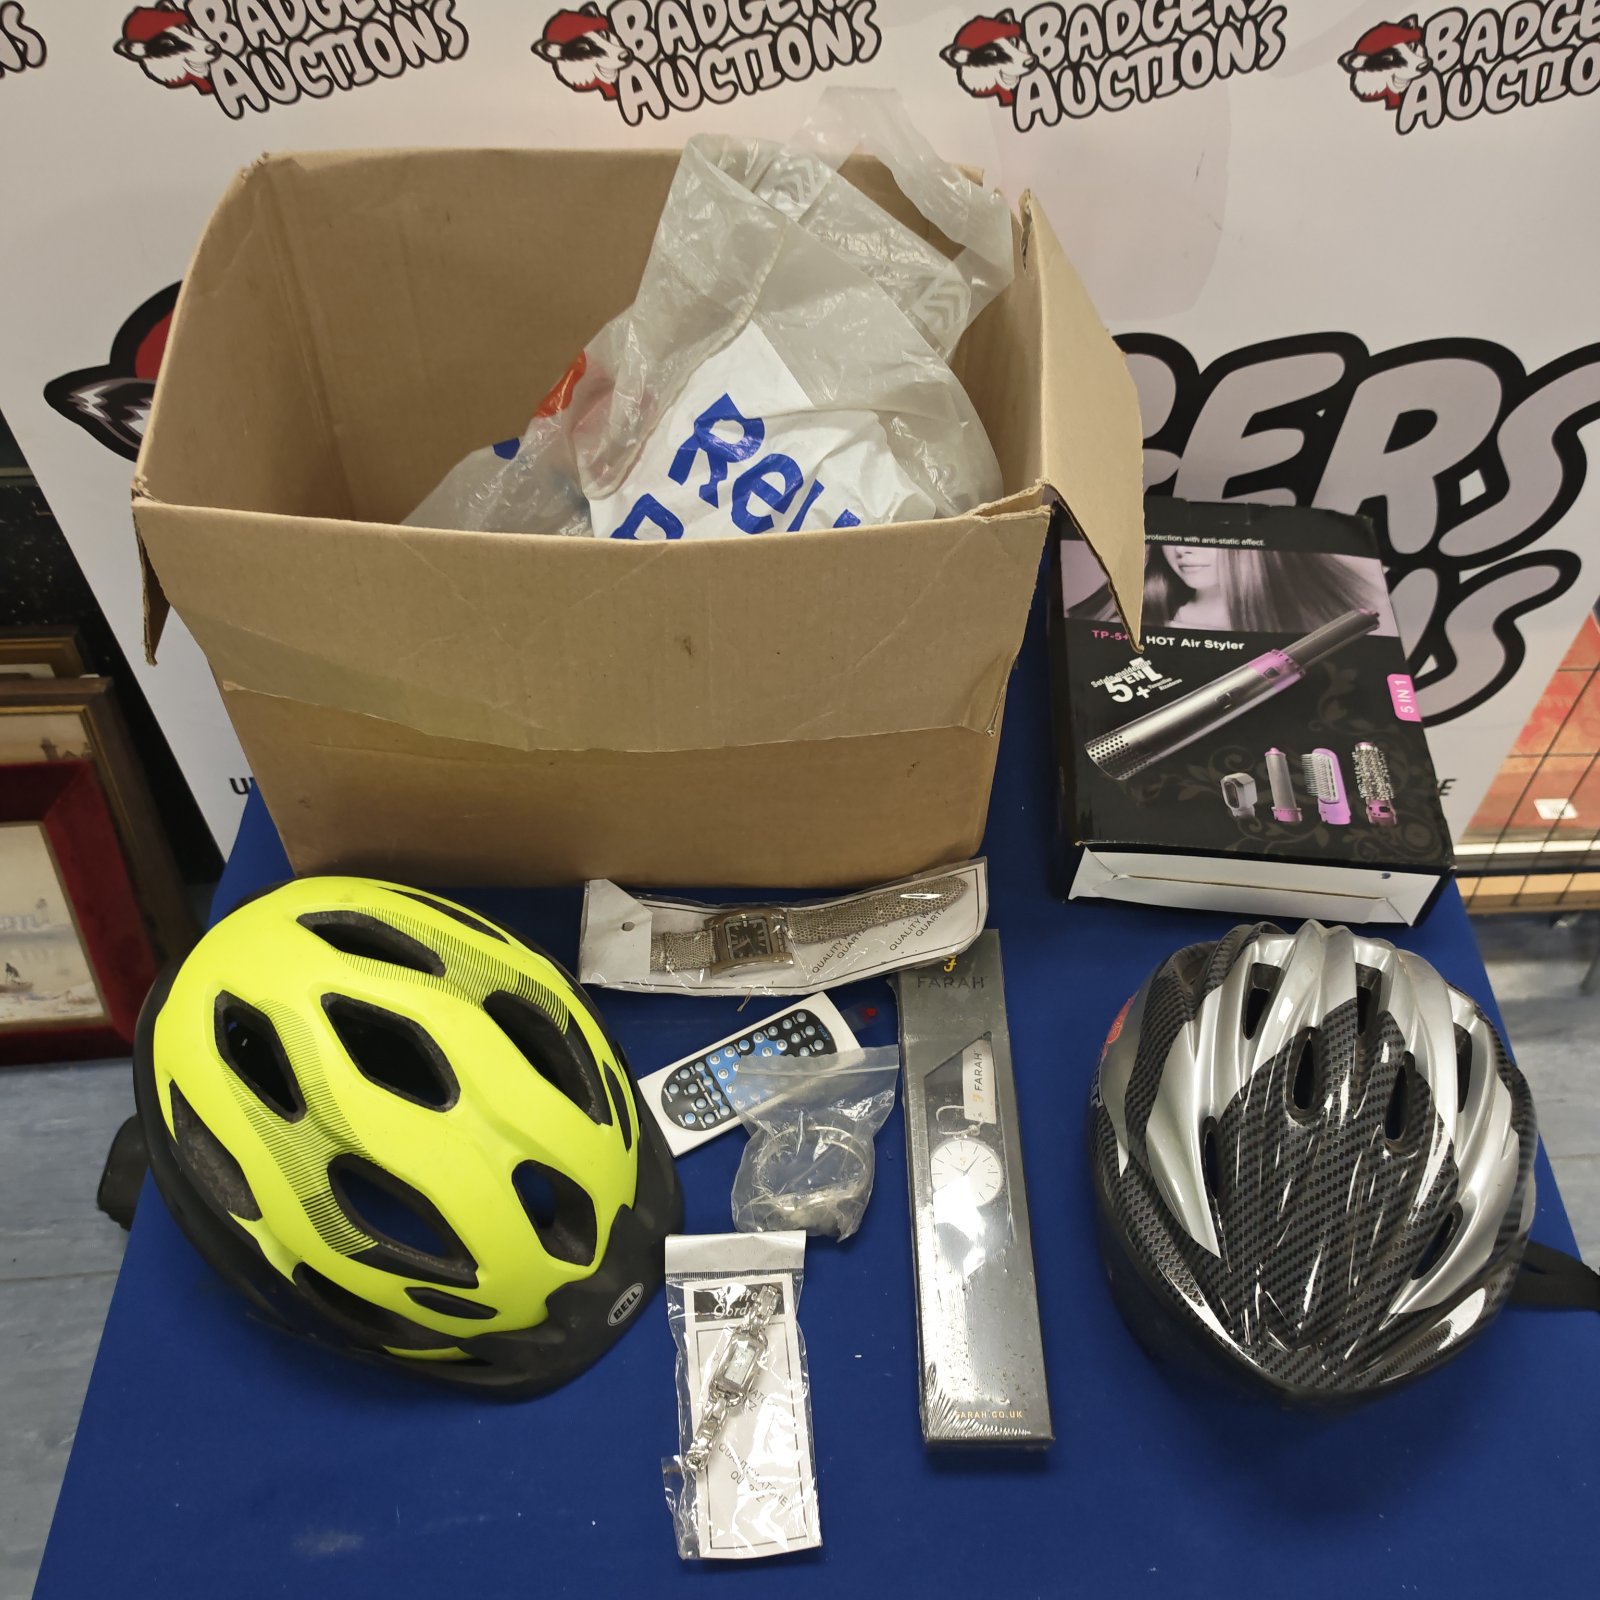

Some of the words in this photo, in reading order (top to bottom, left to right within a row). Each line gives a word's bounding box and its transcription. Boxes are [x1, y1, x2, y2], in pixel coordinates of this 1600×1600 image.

[200, 0, 430, 56] BADG
[606, 0, 852, 64] BADG
[209, 0, 469, 120] AUCTIONS
[617, 0, 882, 127] AUCTIONS
[1012, 5, 1287, 133] AUCTIONS
[1184, 535, 1200, 543] with
[1201, 537, 1240, 545] anti-static
[1146, 635, 1175, 647] HOT
[1181, 638, 1201, 648] Air
[1204, 640, 1246, 651] Styler
[1396, 689, 1412, 703] IN
[1400, 705, 1415, 714] 5
[889, 918, 921, 952] QUALITY
[811, 939, 843, 974] QUALITY
[917, 975, 985, 989] FARAH
[974, 1051, 983, 1092] FARAH
[613, 1291, 640, 1321] BELL
